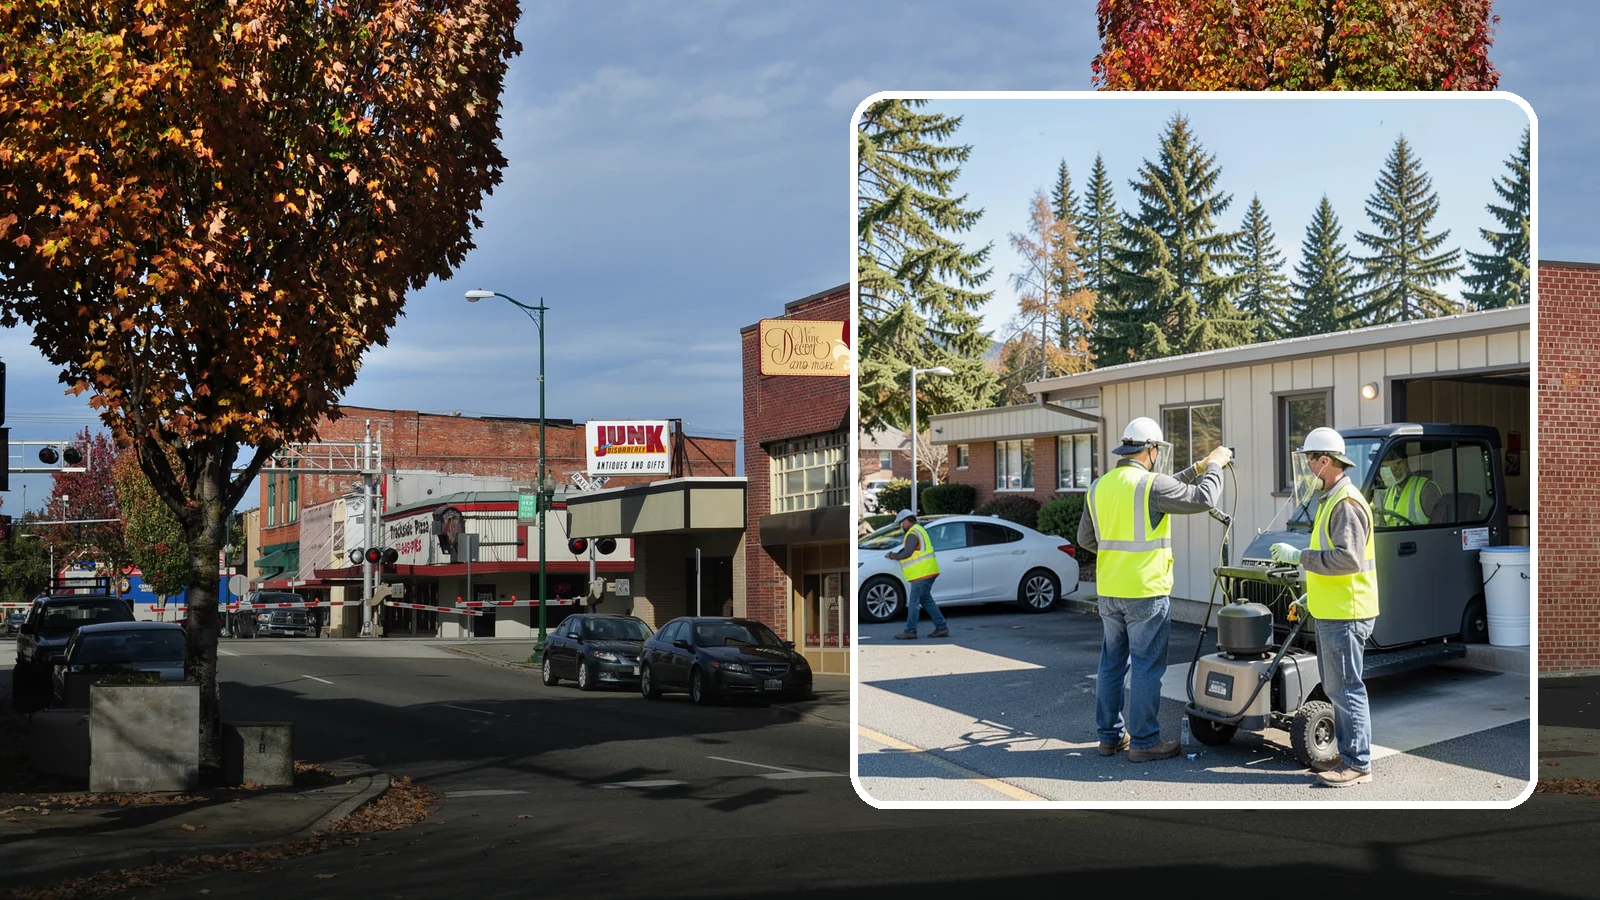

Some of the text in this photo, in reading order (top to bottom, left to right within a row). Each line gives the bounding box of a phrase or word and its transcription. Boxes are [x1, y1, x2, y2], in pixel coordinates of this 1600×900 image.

[595, 425, 665, 457] JUNK
[597, 460, 665, 470] ANTIQUES AND GIFTS
[573, 473, 588, 490] RAIL
[415, 519, 429, 535] Pizza
